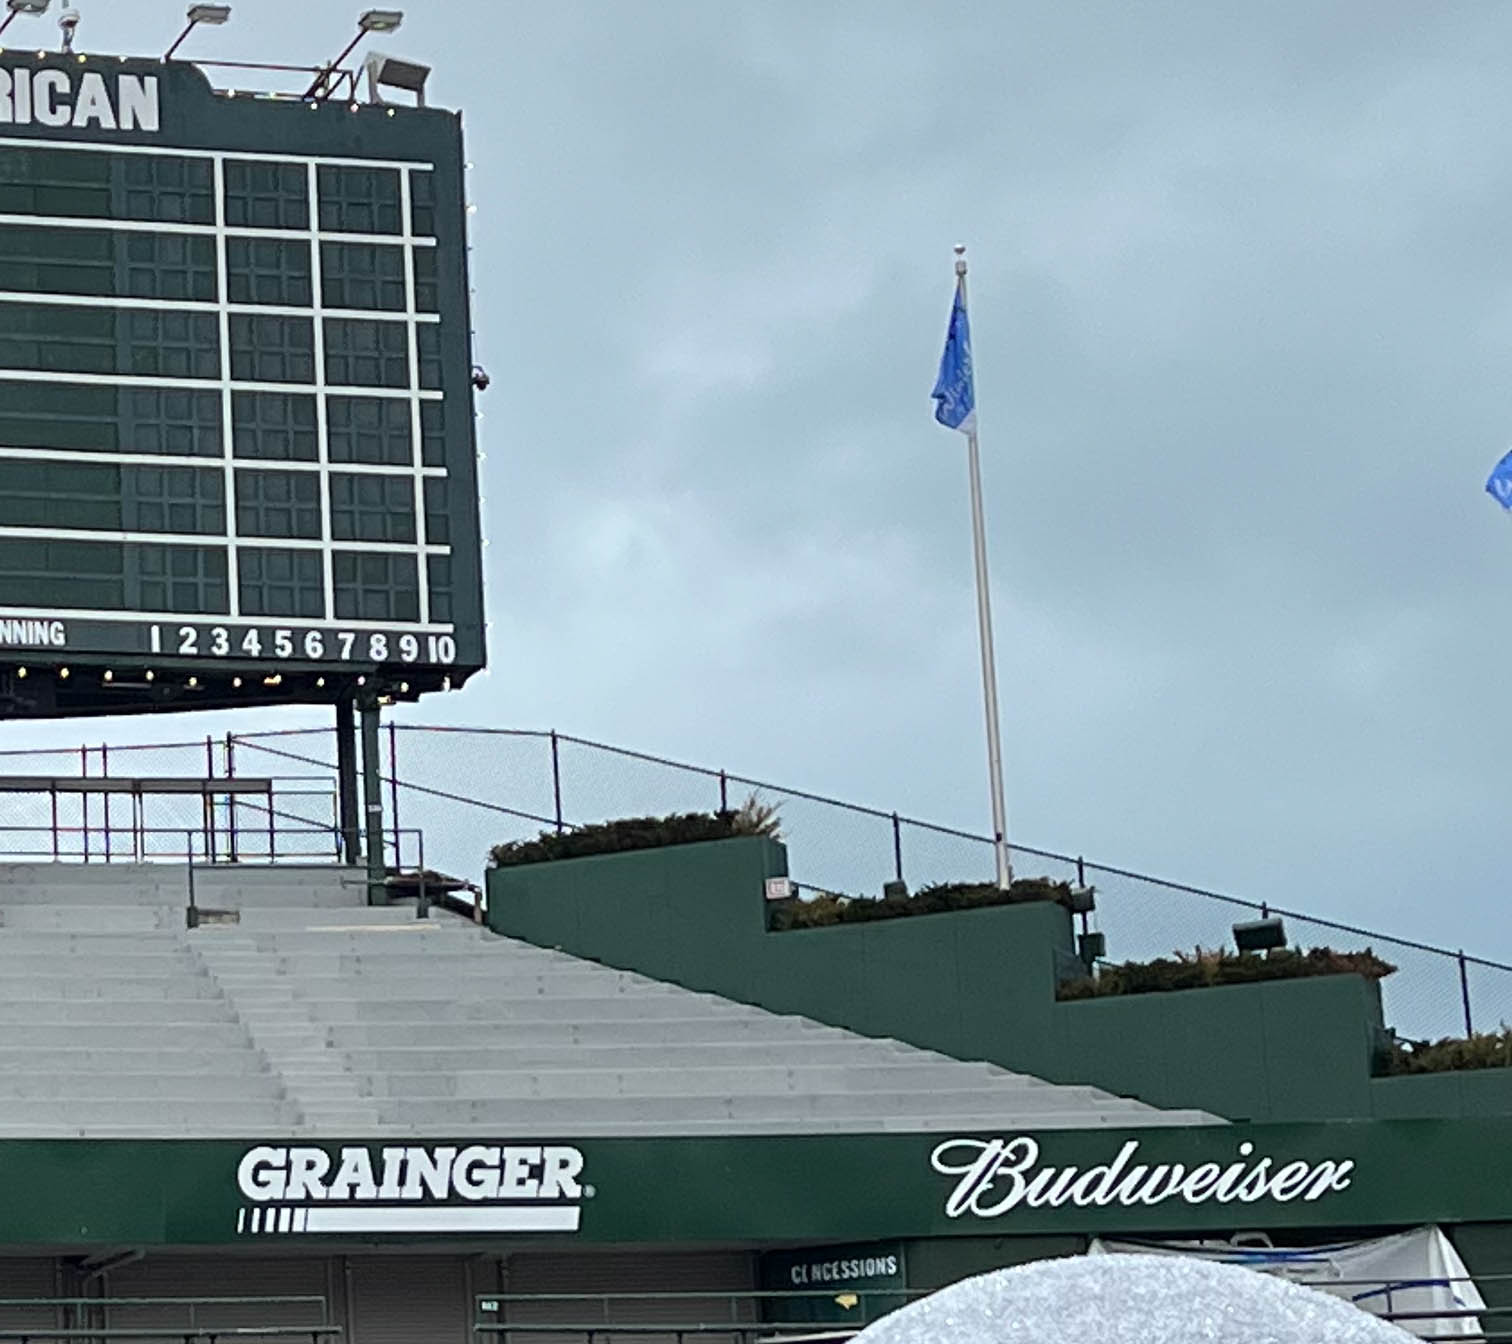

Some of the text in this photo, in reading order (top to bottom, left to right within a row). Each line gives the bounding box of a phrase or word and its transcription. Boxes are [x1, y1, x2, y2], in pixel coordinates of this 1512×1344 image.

[150, 624, 161, 653] 1
[178, 626, 198, 655] 2
[211, 626, 230, 656] 3
[241, 628, 262, 657] 4
[274, 629, 293, 658] 5
[304, 630, 324, 659] 6
[337, 632, 356, 660] 7
[369, 633, 389, 662] 8
[399, 634, 419, 663] 9
[427, 635, 456, 664] 10
[237, 1145, 584, 1202] GRAINGER
[931, 1136, 1355, 1218] Budweiser
